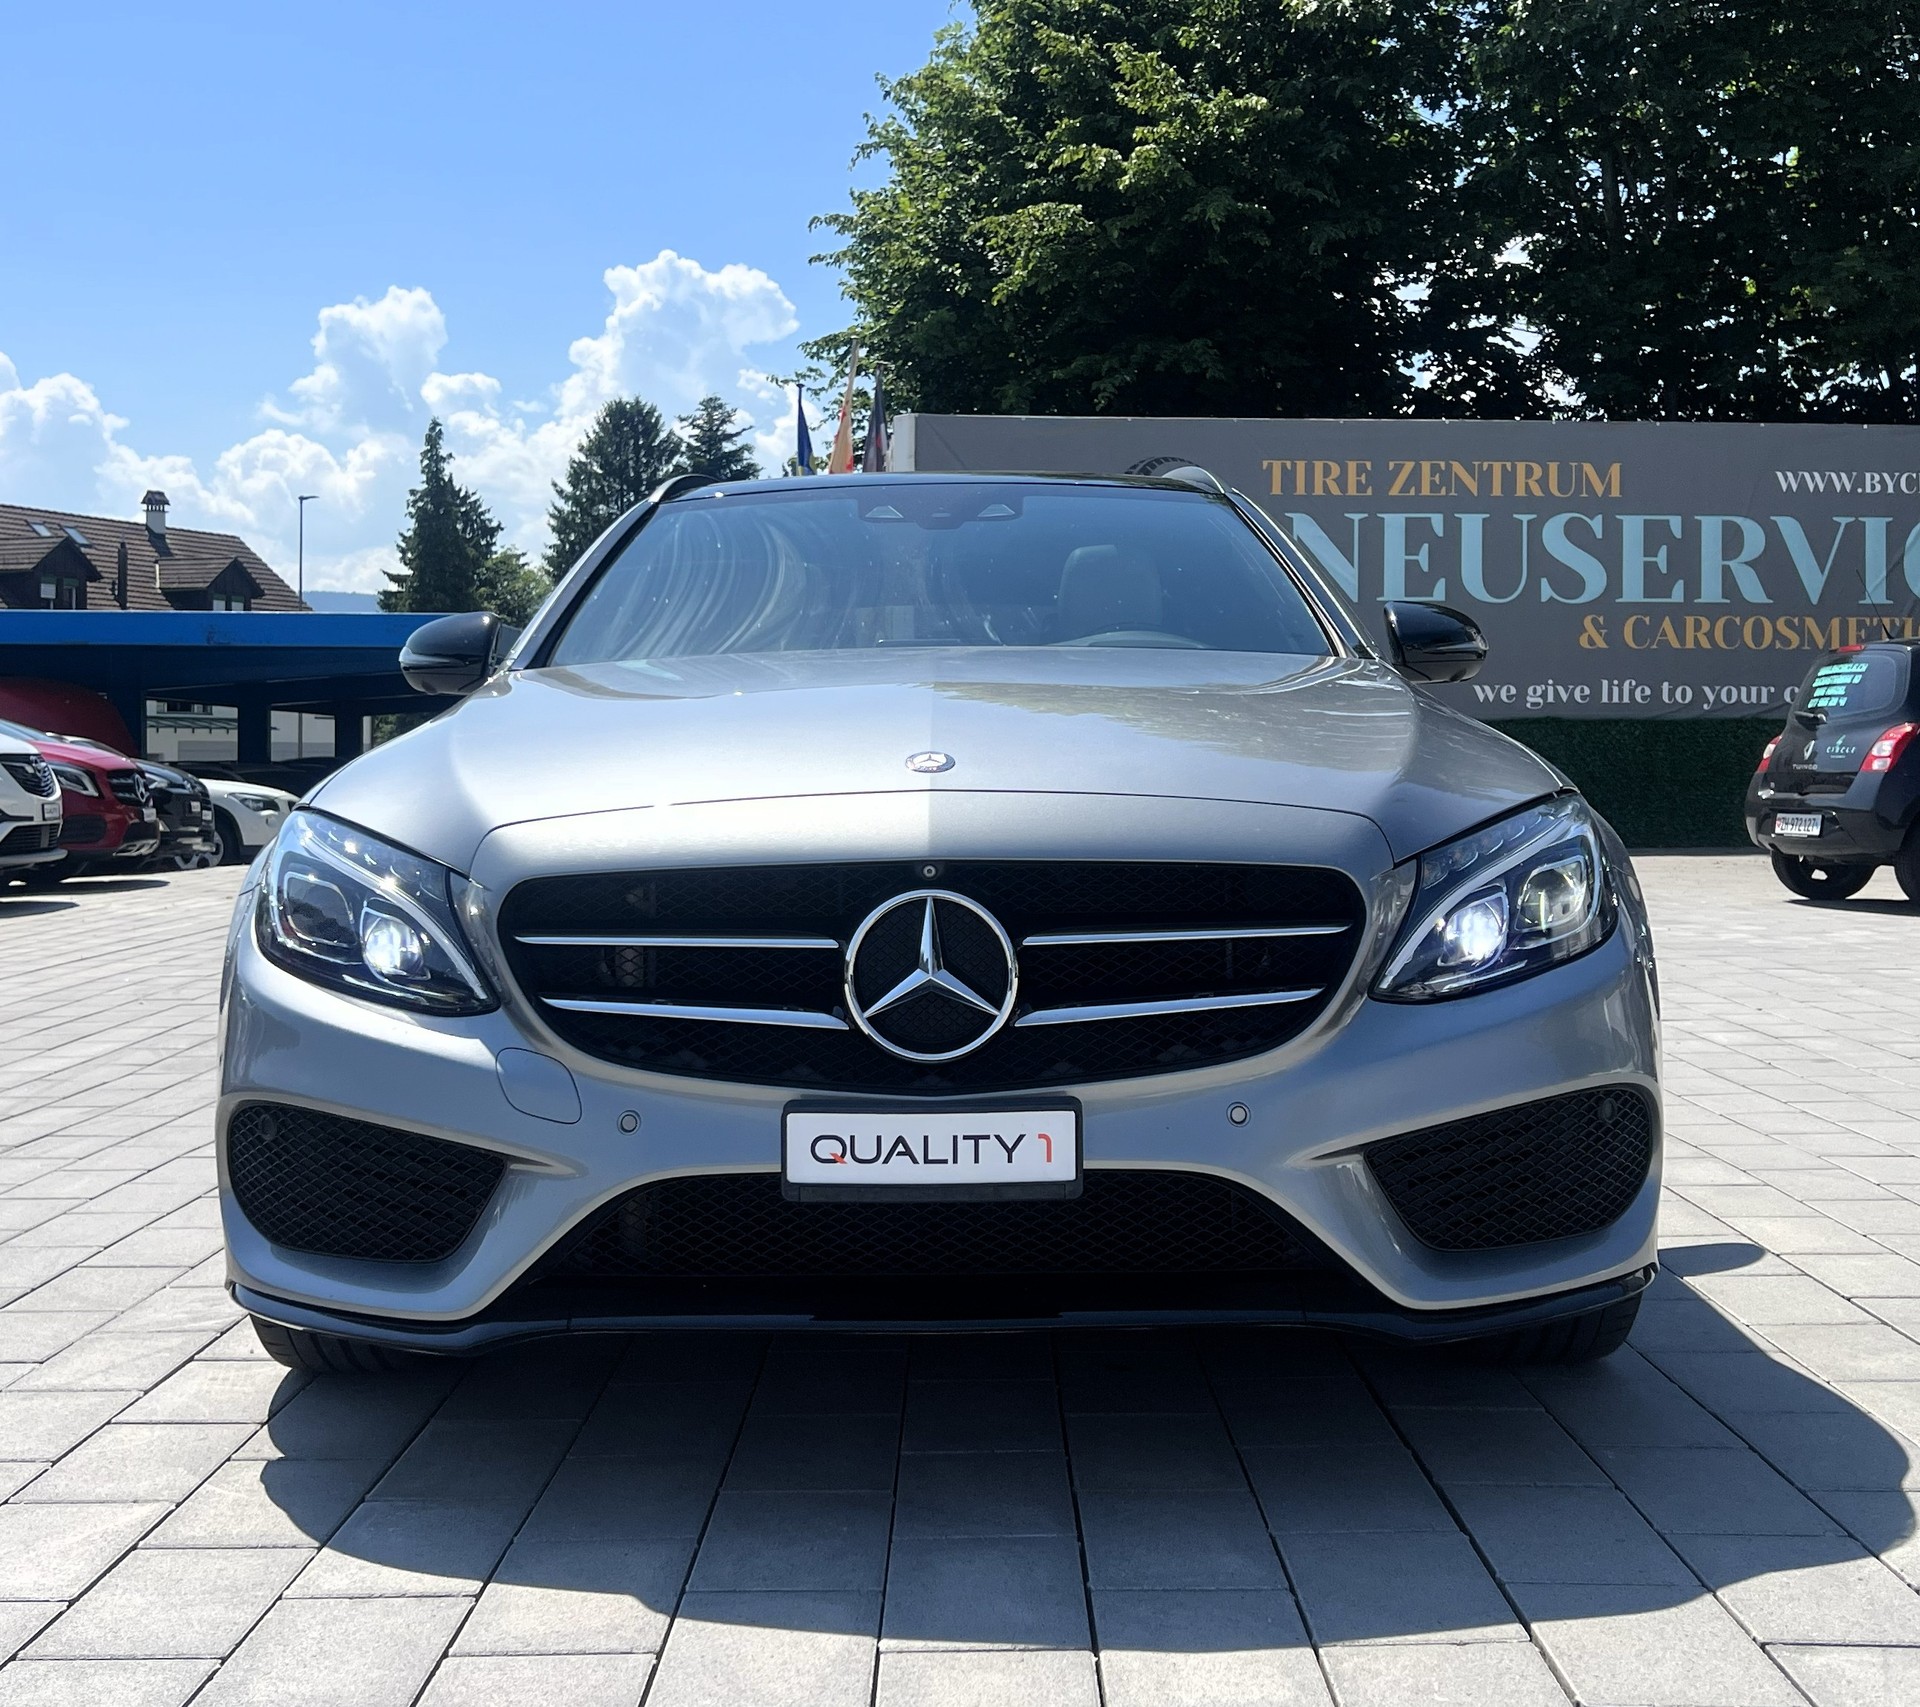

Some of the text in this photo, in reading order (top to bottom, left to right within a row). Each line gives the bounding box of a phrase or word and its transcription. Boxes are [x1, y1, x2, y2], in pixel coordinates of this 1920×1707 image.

[1263, 460, 1623, 498] TIRE ZENTRUM
[1775, 470, 1920, 495] WWW.BYC
[1284, 512, 1920, 605] NEUSERVI
[1578, 614, 1920, 650] & CARCOSMETI
[1472, 684, 1517, 704] we
[1525, 678, 1591, 710] give
[1600, 678, 1652, 704] life
[1661, 681, 1693, 704] to
[1701, 684, 1775, 711] your
